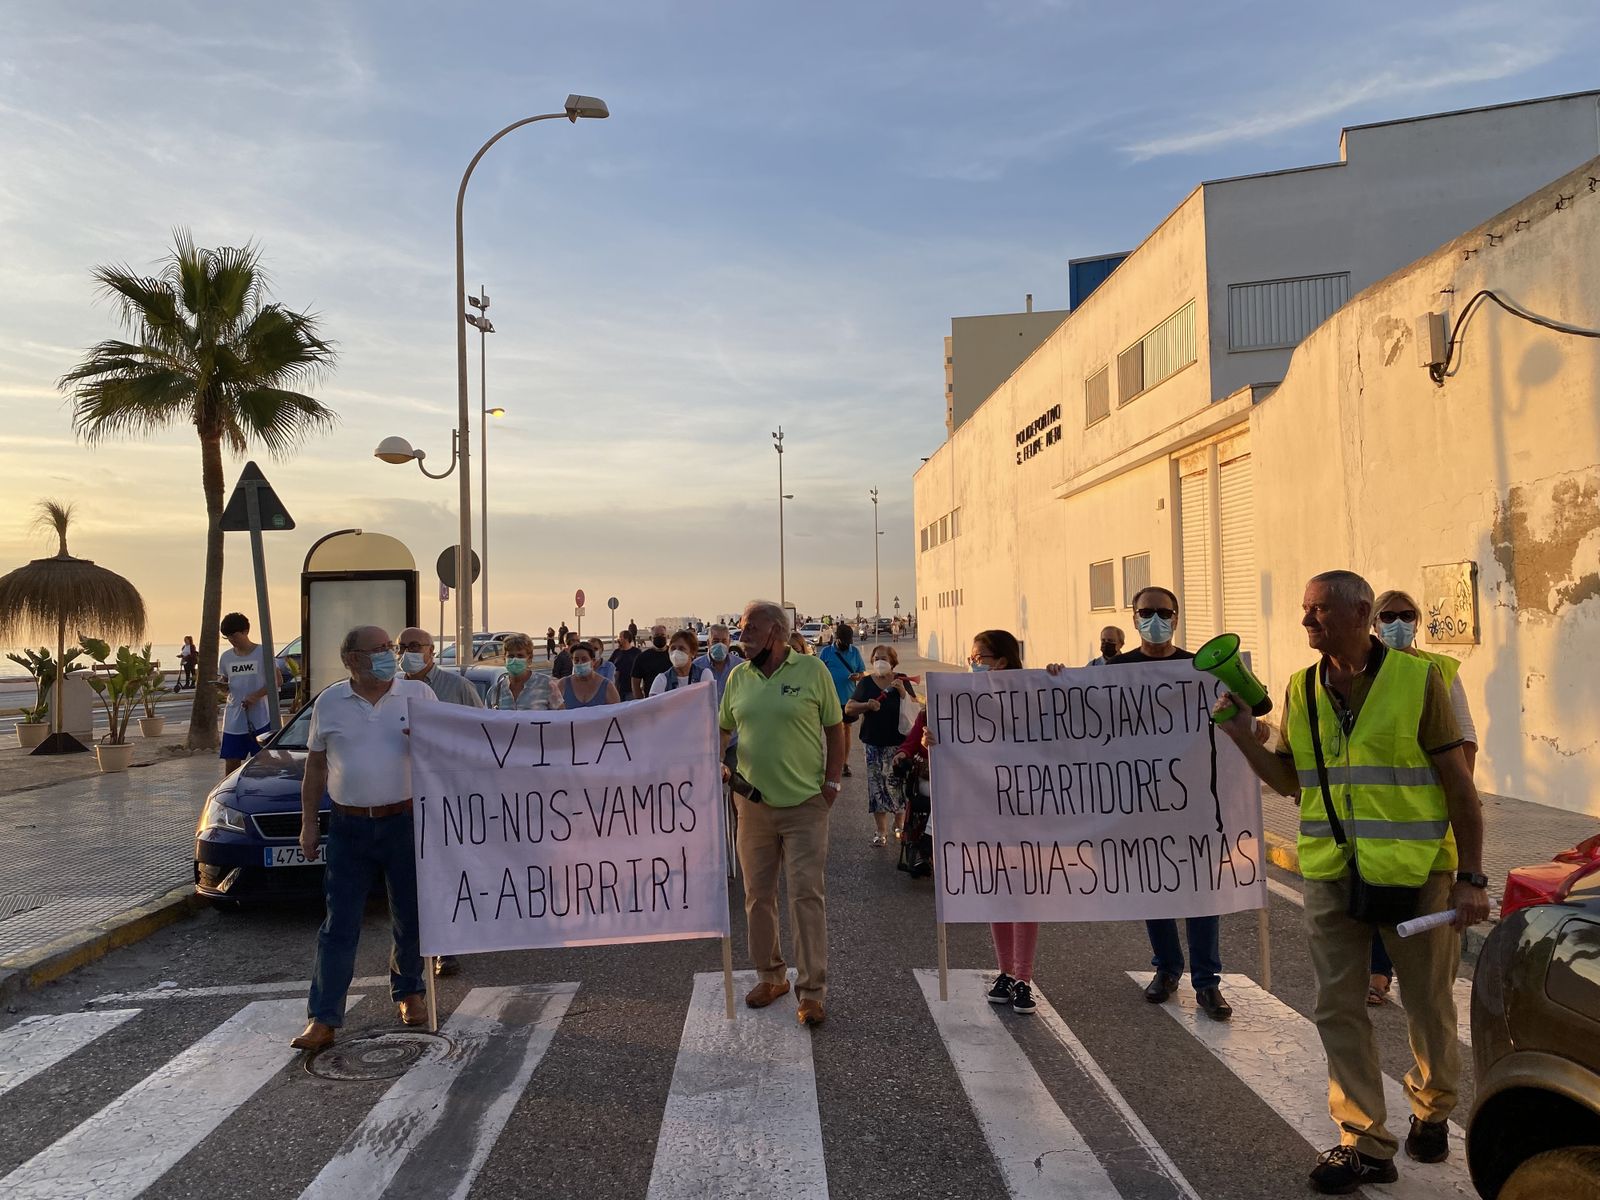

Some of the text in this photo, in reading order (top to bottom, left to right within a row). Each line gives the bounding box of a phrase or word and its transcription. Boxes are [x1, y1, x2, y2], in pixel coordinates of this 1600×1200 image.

[232, 664, 254, 673] RAW.
[480, 716, 632, 769] VILA
[994, 757, 1188, 816] REPARTIDORES
[276, 848, 315, 864] 475
